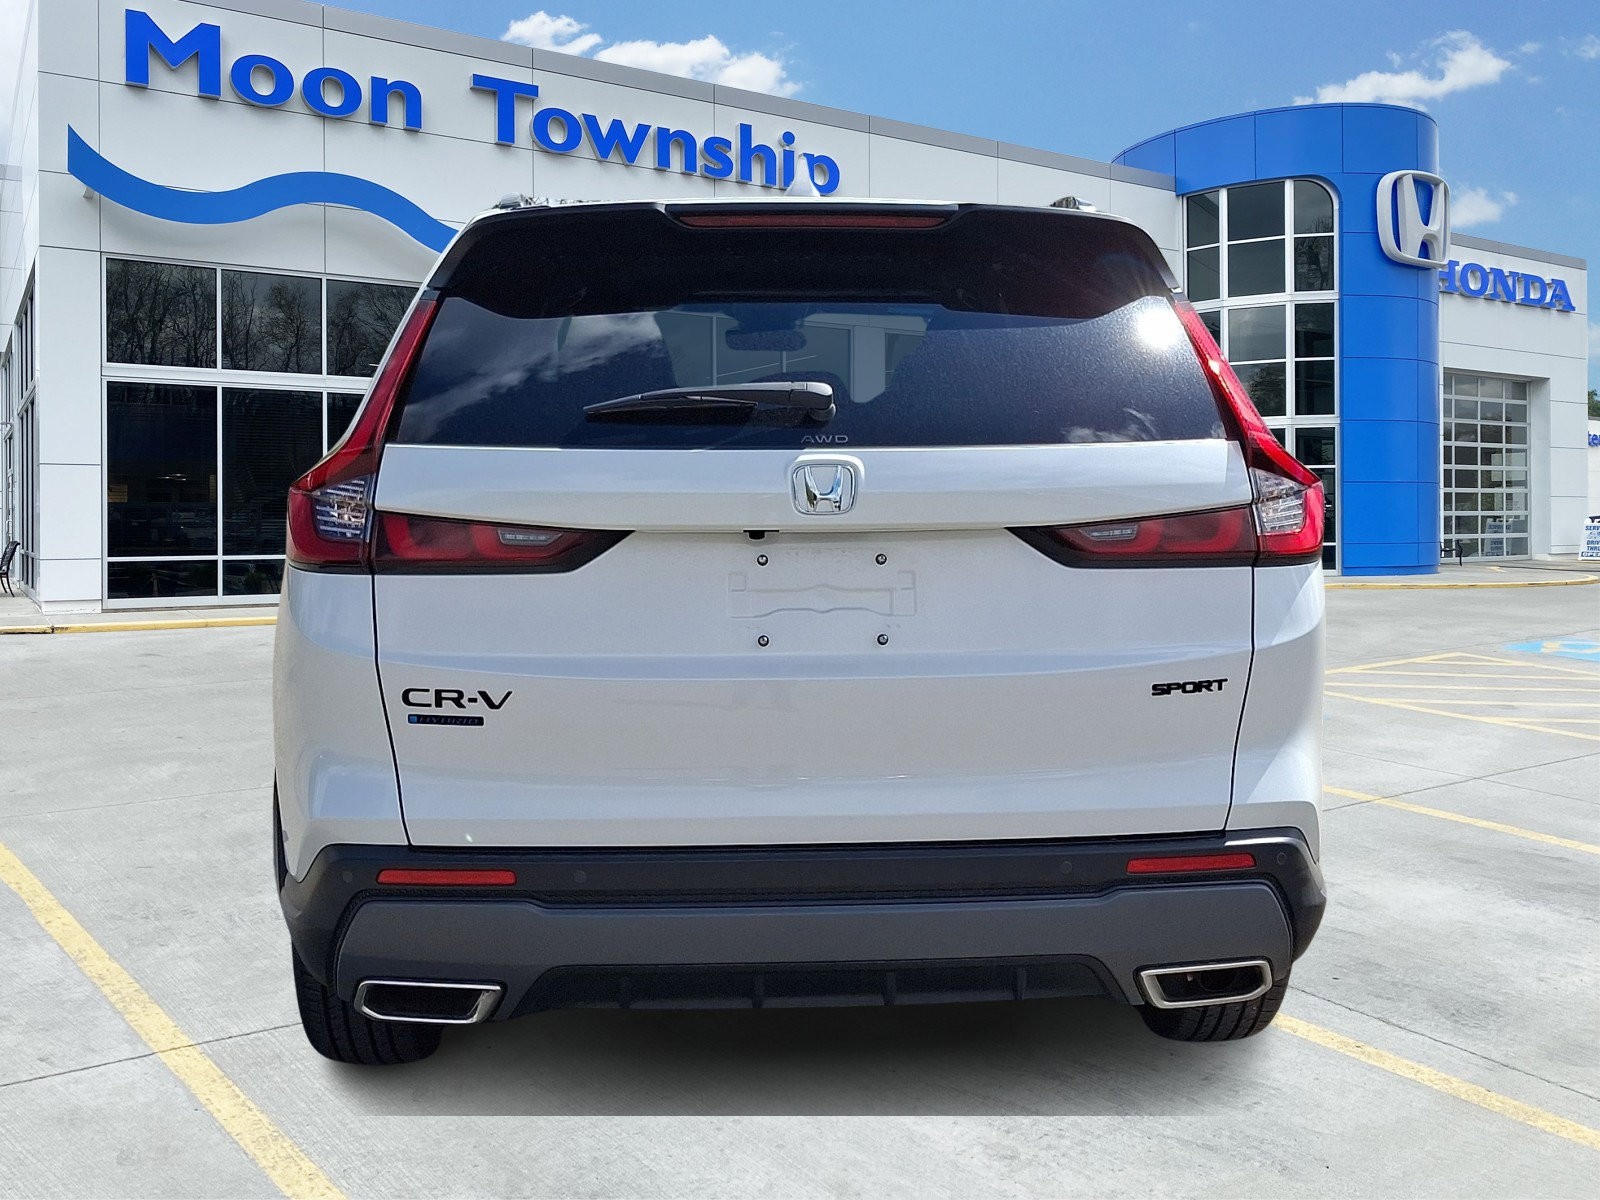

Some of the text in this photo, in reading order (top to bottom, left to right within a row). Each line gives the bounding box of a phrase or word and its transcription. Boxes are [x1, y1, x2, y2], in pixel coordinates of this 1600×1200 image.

[125, 9, 840, 195] Moon Township
[1439, 259, 1576, 312] HONDA
[800, 434, 849, 444] AWD
[1151, 678, 1228, 696] SPORT
[401, 688, 513, 710] CR-V
